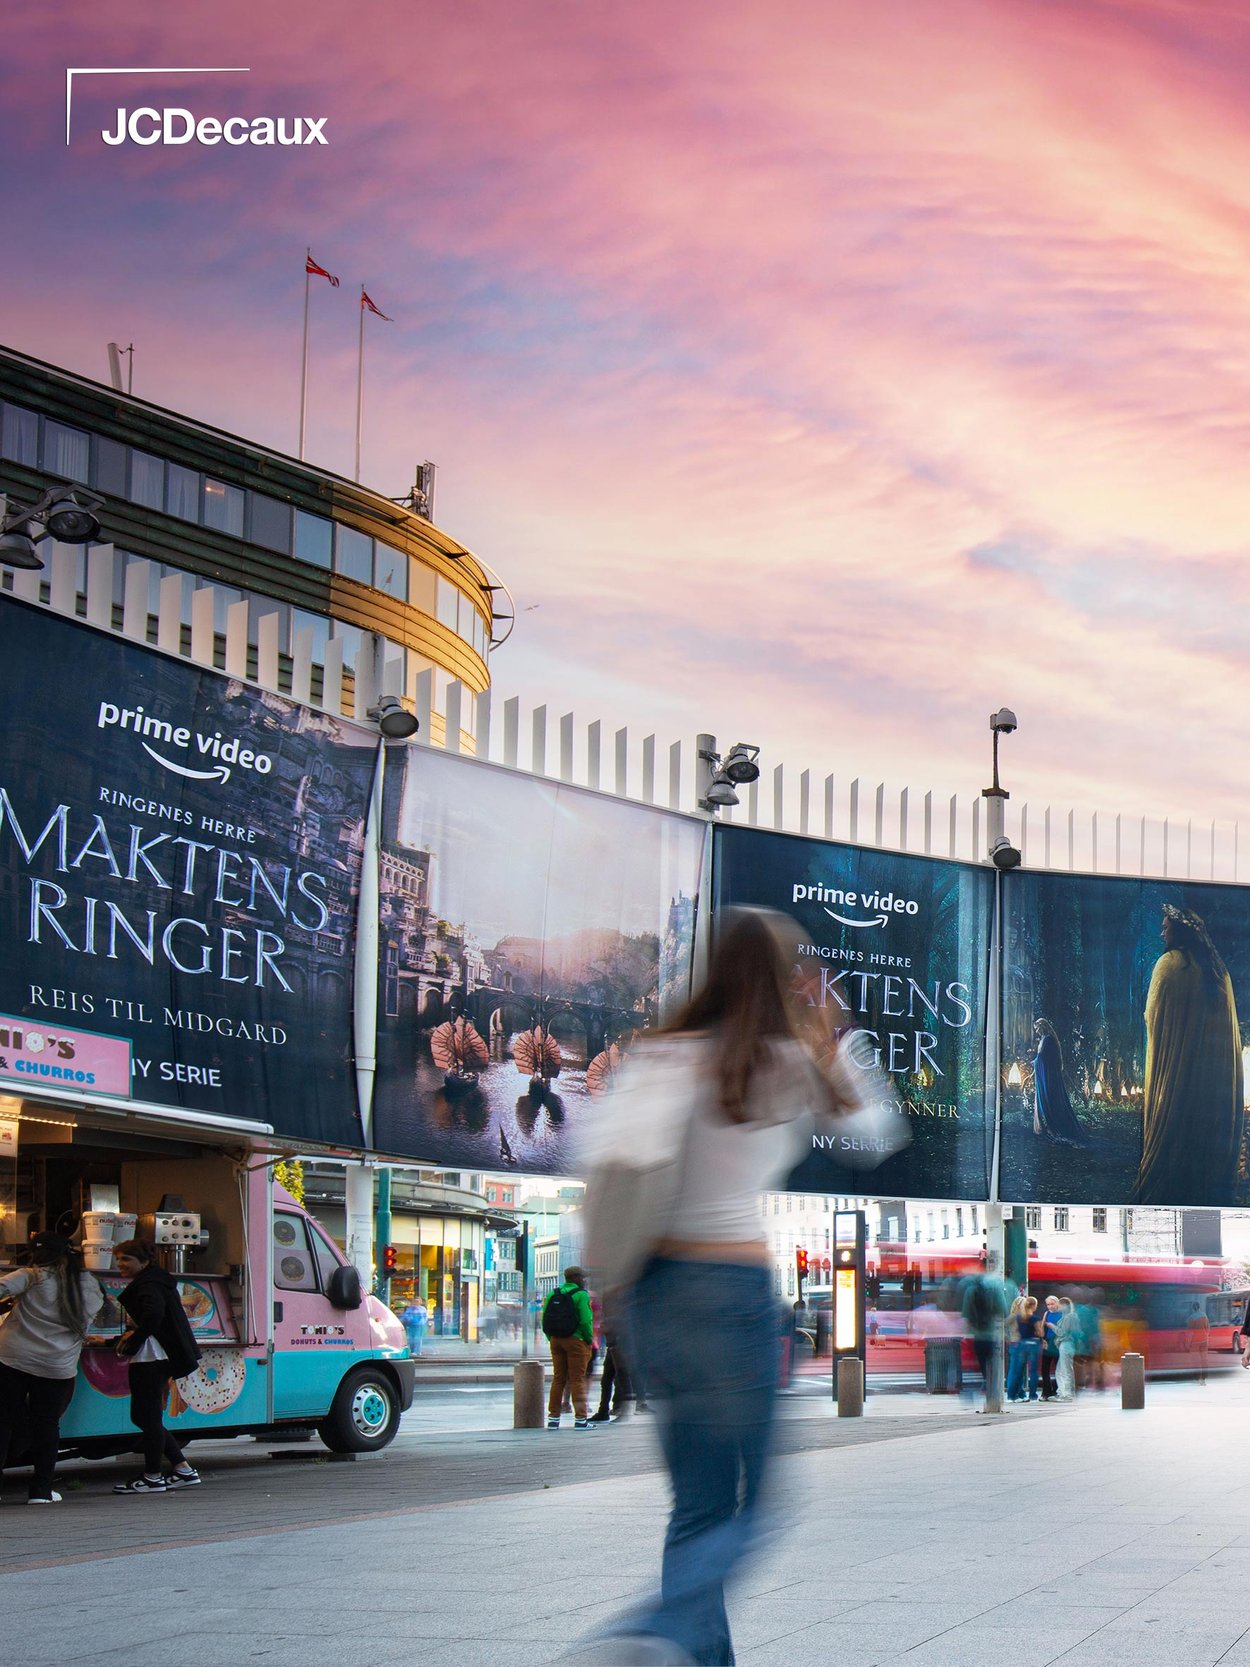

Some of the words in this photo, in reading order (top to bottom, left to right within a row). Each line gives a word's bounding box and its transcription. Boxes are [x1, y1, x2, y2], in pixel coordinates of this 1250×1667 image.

[98, 701, 189, 748] prime
[196, 731, 273, 775] video
[99, 785, 193, 827] RINGENES
[200, 815, 257, 844] HERRE
[0, 787, 331, 933] MAKTENS
[793, 881, 857, 906] prime
[861, 890, 919, 915] video
[27, 877, 295, 995] RINGER
[797, 943, 864, 962] RINGENES
[870, 953, 912, 969] HERRE
[29, 984, 95, 1016] REIS
[105, 996, 153, 1025] TIL
[164, 1009, 287, 1046] MIDGARD
[788, 964, 972, 1028] AKTENS
[15, 1059, 96, 1085] CHURROS
[160, 1062, 223, 1087] SERIE
[812, 1134, 836, 1150] NY
[300, 1324, 345, 1335] TONIO'S
